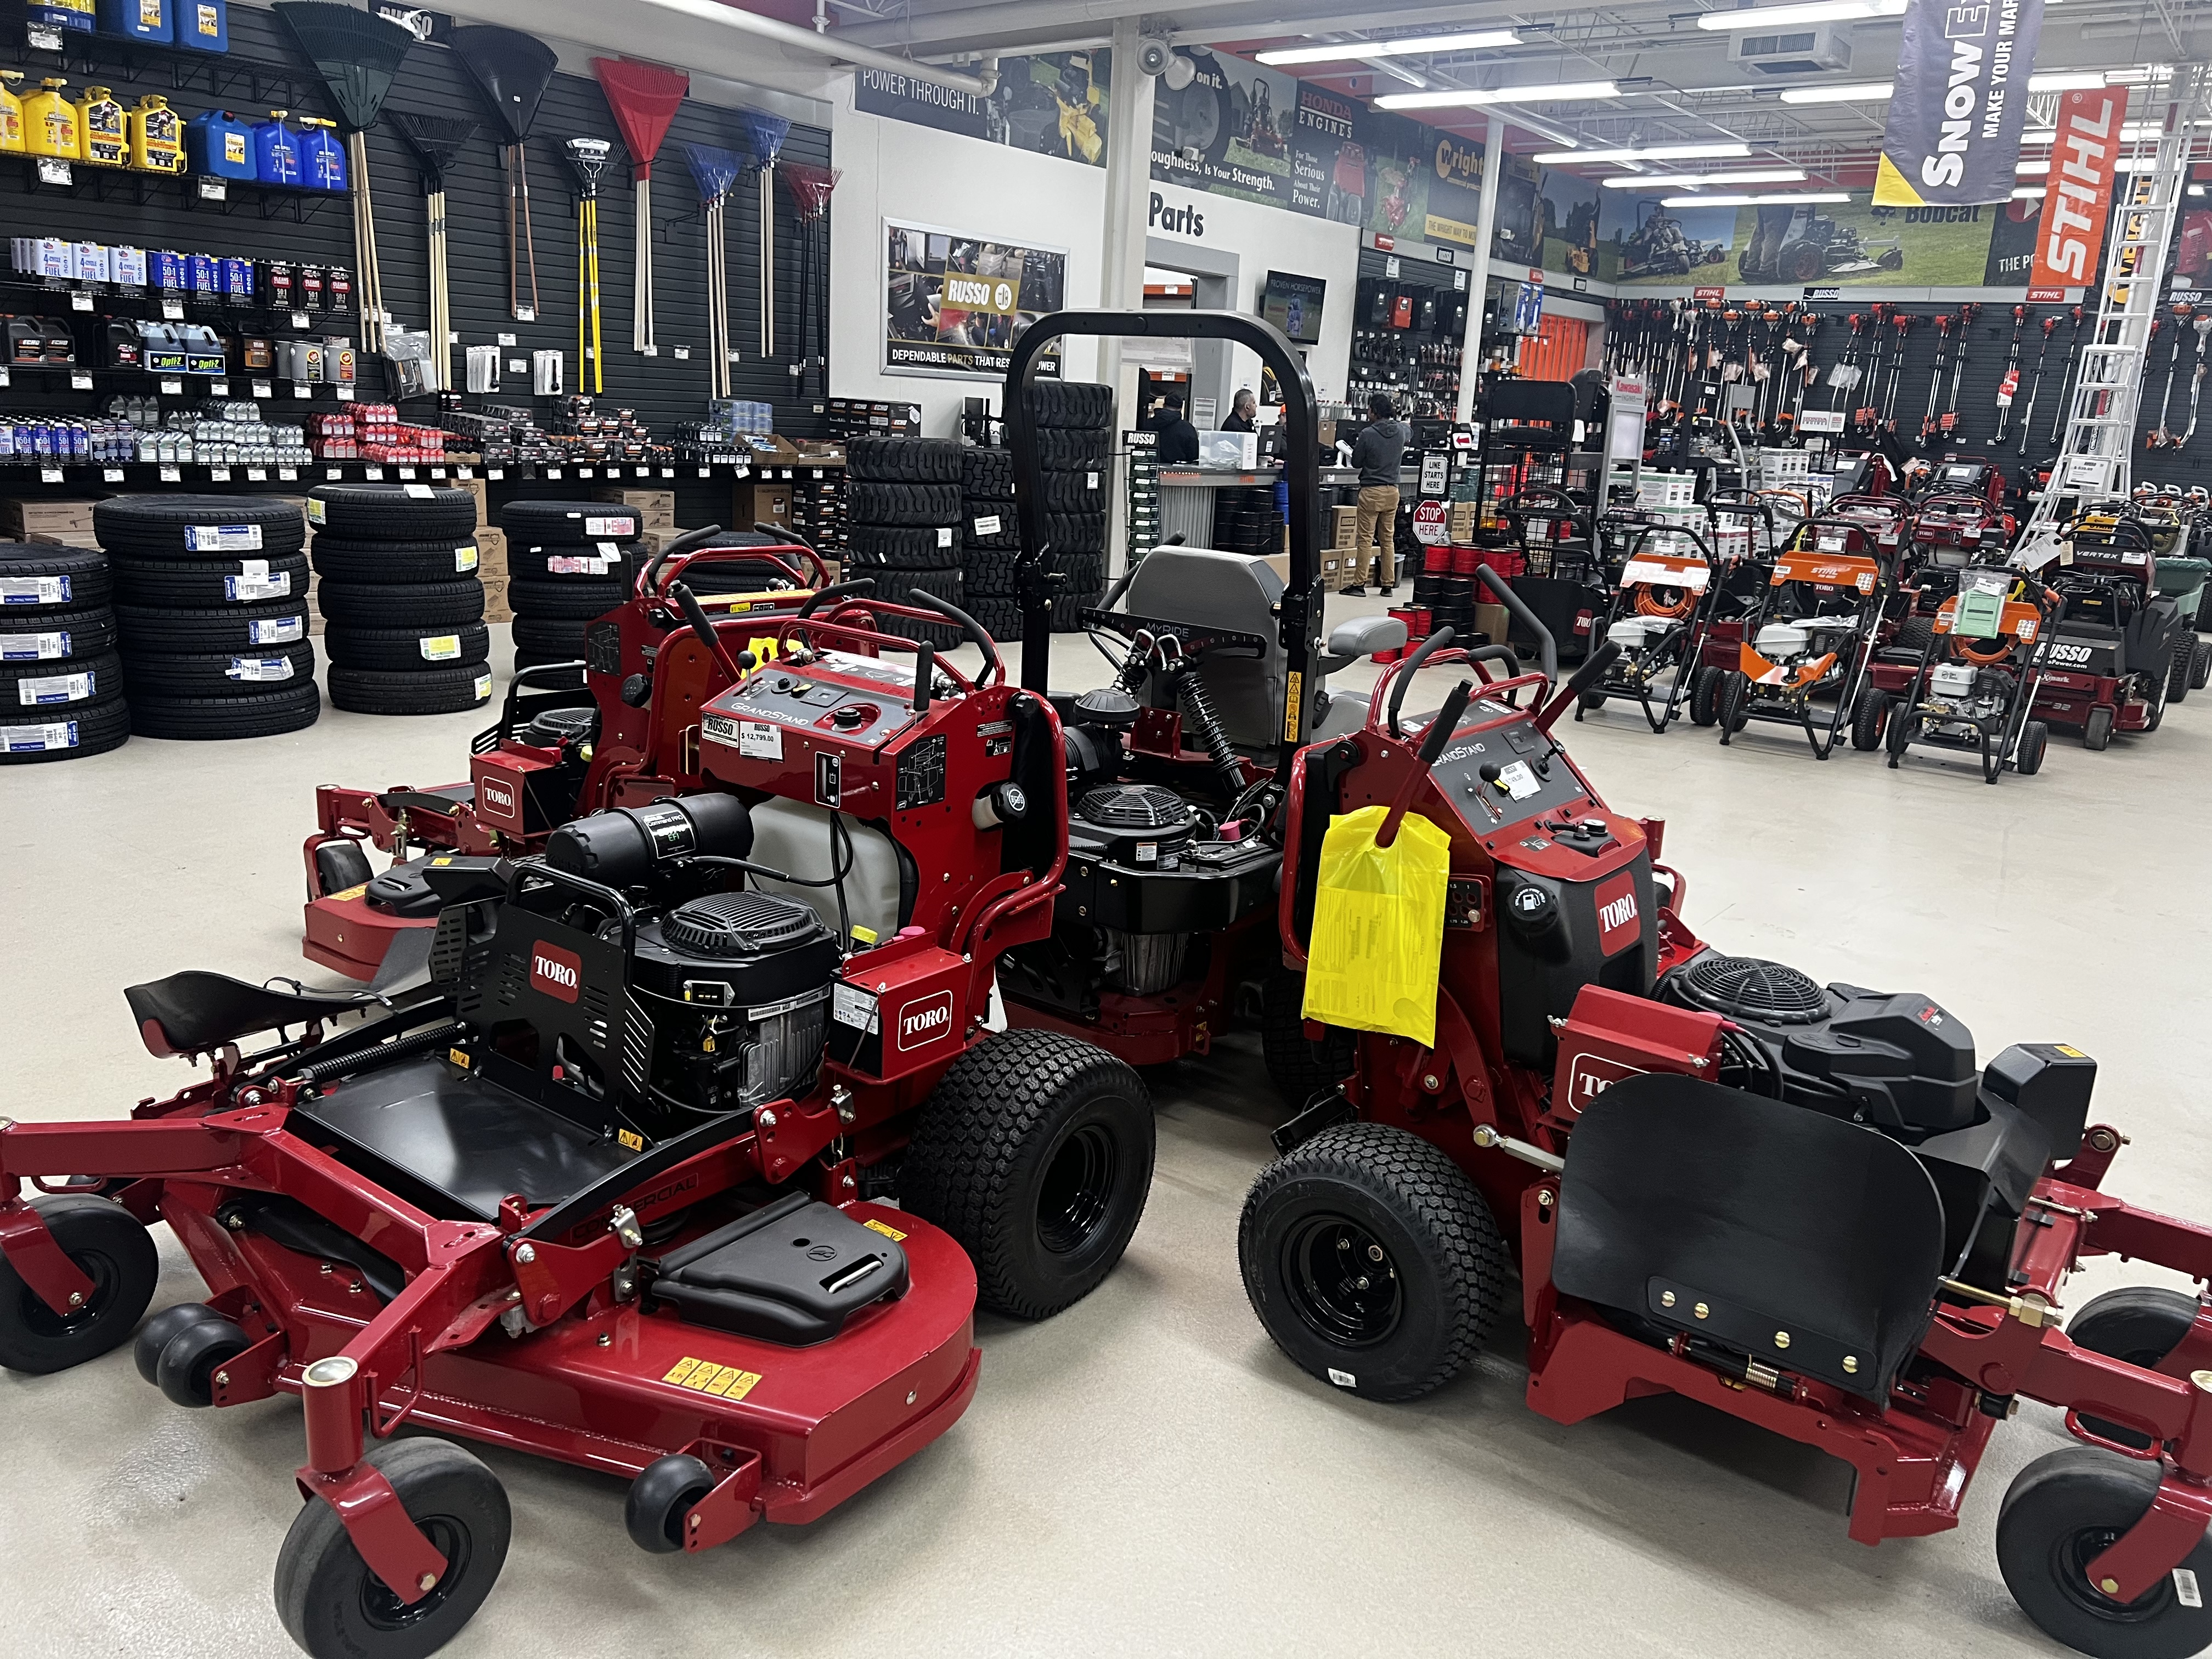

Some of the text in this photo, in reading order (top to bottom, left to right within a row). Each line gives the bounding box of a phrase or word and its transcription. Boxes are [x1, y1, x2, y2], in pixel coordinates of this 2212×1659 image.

[1991, 41, 2013, 86] YOUR
[1197, 71, 1210, 86] on
[864, 70, 905, 97] POWER
[910, 78, 964, 111] THROUGH
[1301, 91, 1352, 121] HONDA
[1982, 91, 2005, 138] MAKE
[1299, 111, 1352, 138] ENGINES
[1151, 151, 1275, 191] oughness, Is Your Strength.
[1294, 160, 1325, 181] Serious
[2047, 98, 2112, 280] STIHL
[1293, 189, 1320, 208] Power.
[1149, 191, 1204, 236] Parts
[163, 266, 176, 276] 50:1
[1999, 256, 2019, 273] THE
[45, 267, 61, 276] FUEL
[82, 270, 97, 280] FUEL
[196, 269, 209, 279] 50:1
[230, 273, 243, 282] 50:1
[120, 274, 136, 284] FUEL
[163, 279, 178, 288] FUEL
[197, 281, 211, 291] FUEL
[230, 284, 245, 294] FUEL
[947, 280, 990, 306] RUSSO
[2169, 292, 2203, 302] RUSSO
[161, 357, 181, 366] Opti-2
[199, 359, 219, 369] Opti-2
[892, 349, 946, 363] DEPENDABLE
[947, 353, 973, 365] PARTS
[974, 355, 995, 367] THAT
[1616, 379, 1642, 394] Kawasaki
[1127, 432, 1155, 445] RUSSO
[1420, 507, 1441, 521] STOP
[1419, 525, 1438, 536] HERE
[2076, 550, 2118, 559] VERTEX
[1811, 567, 1838, 575] STIHL
[2033, 657, 2087, 669] RuoPower.com
[2052, 702, 2071, 711] 32
[707, 718, 733, 736] RUSSO
[754, 723, 770, 732] RUSSO
[747, 733, 774, 742] 12,799.00
[484, 786, 512, 808] TORO
[648, 817, 671, 826] Command
[668, 833, 680, 842] EFI
[1599, 893, 1635, 933] TORO
[535, 956, 577, 988] TORO
[904, 1006, 947, 1035] TORO
